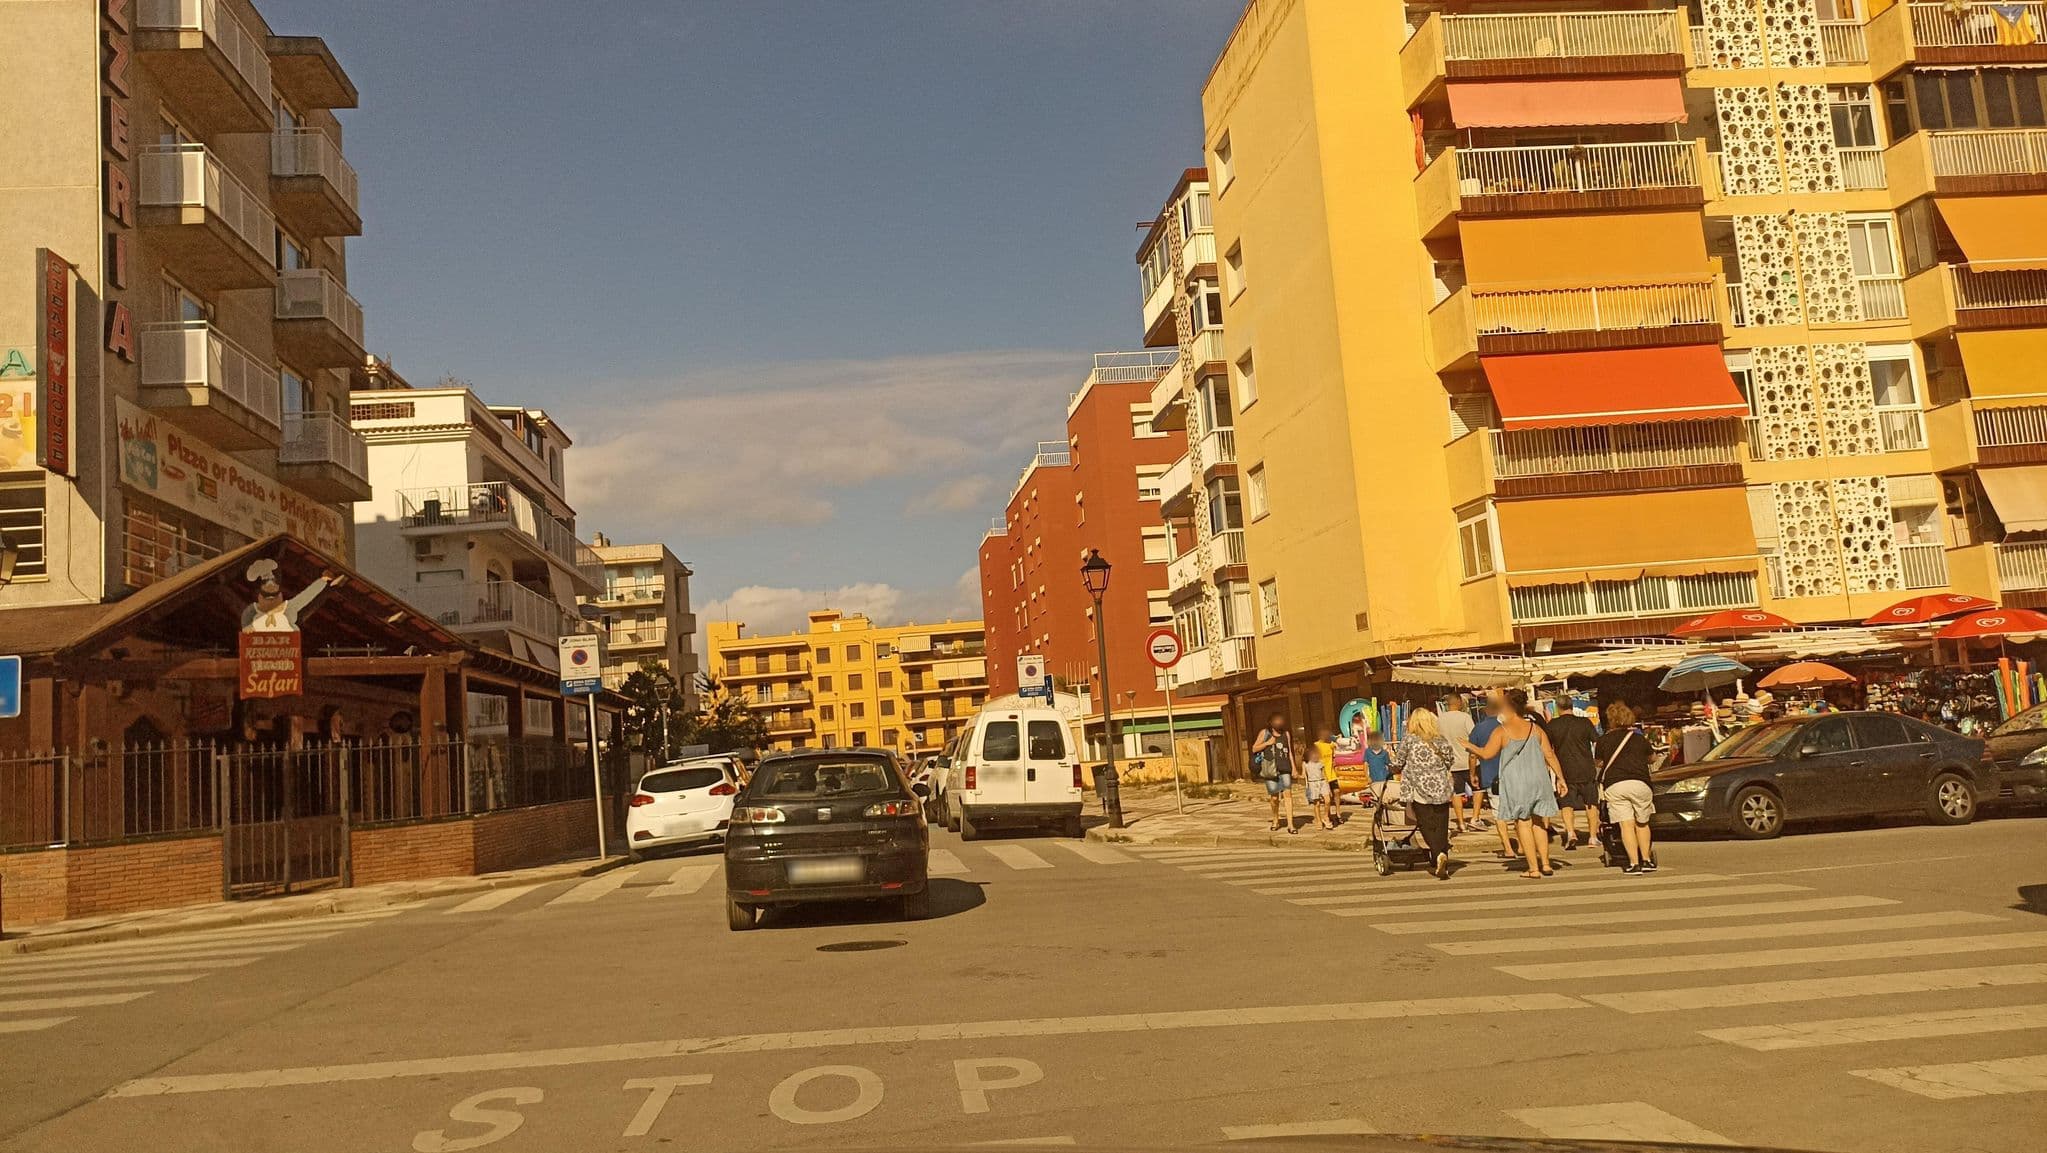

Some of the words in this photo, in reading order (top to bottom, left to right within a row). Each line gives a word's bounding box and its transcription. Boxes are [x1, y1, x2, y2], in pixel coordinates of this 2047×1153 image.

[50, 261, 65, 341] STEAK
[51, 381, 66, 464] HOUSE
[167, 432, 209, 474] Pizza
[212, 461, 227, 483] or
[228, 465, 266, 502] Pasta
[251, 636, 291, 646] BAR
[246, 671, 299, 699] Safari
[411, 1056, 1045, 1153] STOP
